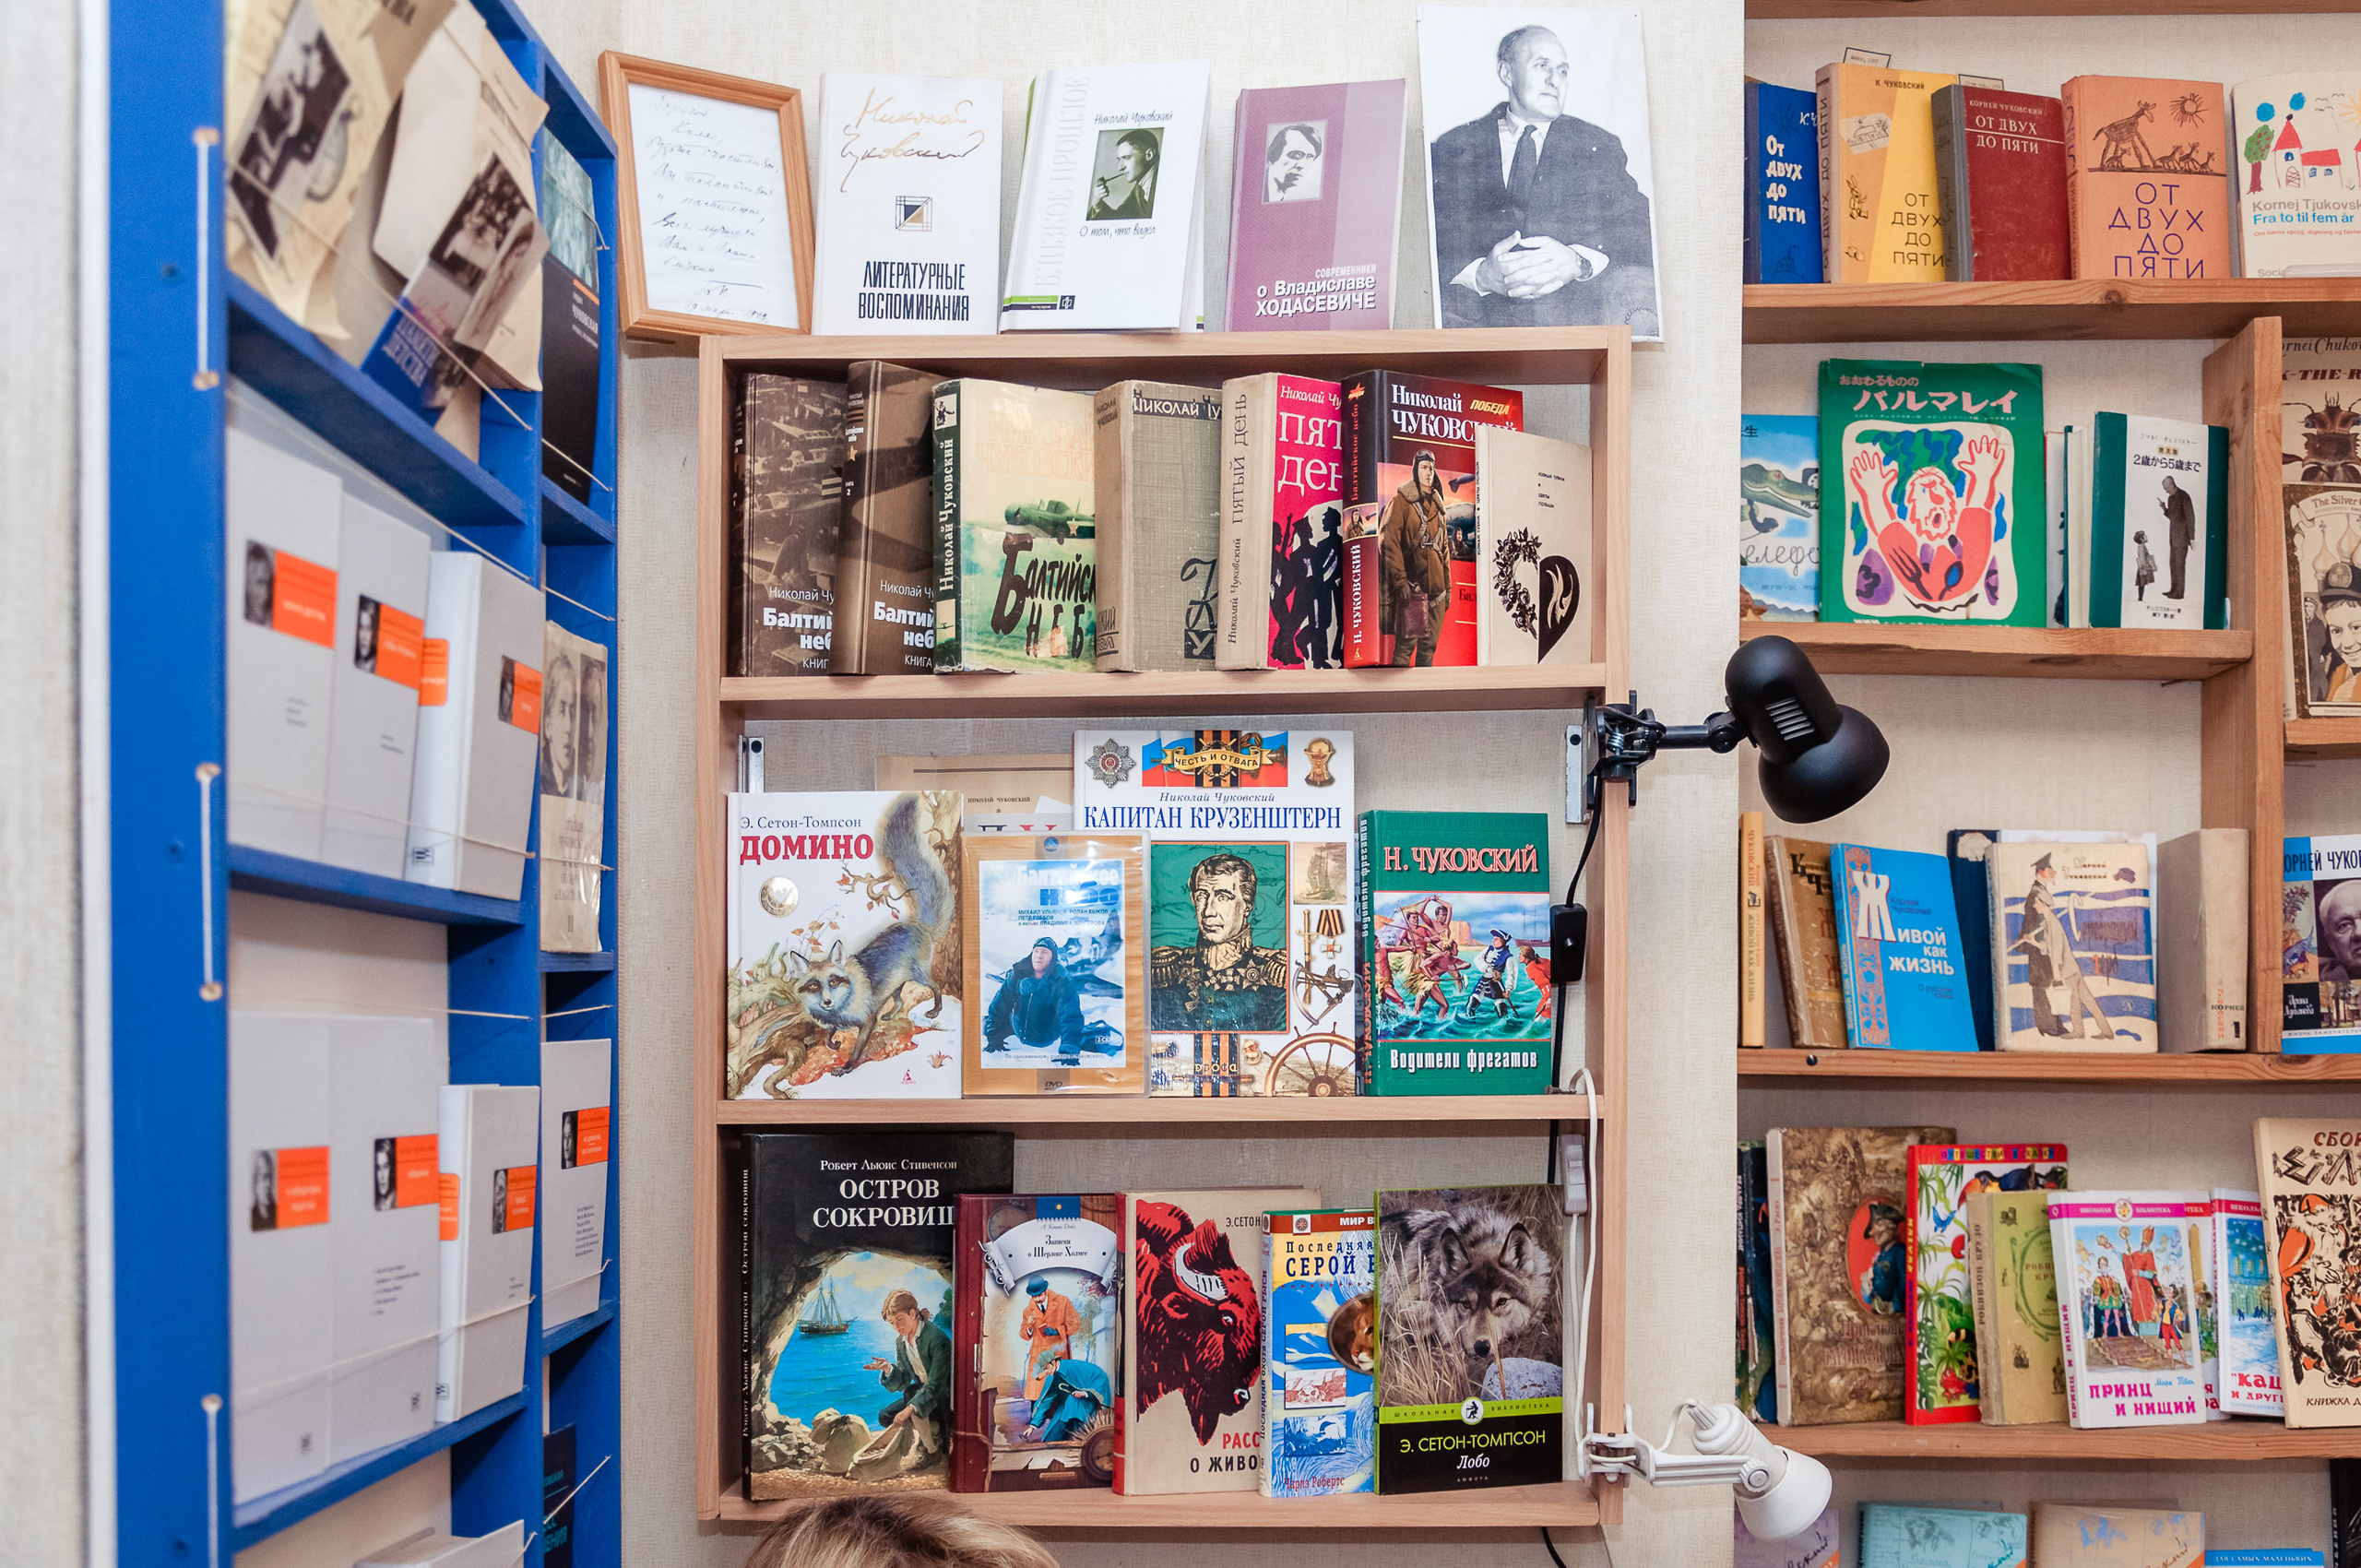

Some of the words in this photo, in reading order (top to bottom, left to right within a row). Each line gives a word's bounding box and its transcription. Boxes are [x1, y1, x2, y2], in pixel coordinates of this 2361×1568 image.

[1884, 80, 1925, 89] ЧУКОВСКИЙ
[1969, 100, 1998, 110] КОРНЕЙ
[1999, 103, 2043, 115] ЧУКОВСКИЙ
[1095, 113, 1130, 125] Николай
[1132, 110, 1174, 127] Чуковский
[1820, 97, 1828, 149] ПЯТИ
[1975, 115, 1996, 129] ОТ
[1999, 118, 2038, 136] ДВУХ
[1975, 135, 1997, 148] ДО
[2002, 137, 2039, 155] ПЯТИ
[1904, 193, 1929, 208] ОТ
[2135, 183, 2180, 206] ОТ
[2252, 199, 2299, 212] Kornej
[1892, 211, 1942, 228] ДВУХ
[2108, 208, 2203, 232] ДВУХ
[2253, 214, 2276, 224] Fra
[2280, 212, 2294, 222] to
[2297, 212, 2308, 222] til
[2312, 212, 2338, 222] fem
[2341, 212, 2355, 222] år
[1079, 226, 1088, 237] О
[1905, 232, 1932, 247] ДО
[2138, 232, 2184, 255] ДО
[1893, 251, 1944, 267] ПЯТИ
[2115, 255, 2203, 278] ПЯТИ
[863, 261, 965, 290] ЛИТЕРАТУРНЫЕ
[1315, 263, 1377, 279] СОВРЕМЕННИКИ
[1257, 285, 1267, 298] о
[1275, 275, 1376, 299] Владиславе
[859, 292, 969, 321] ВОСПОМИНАНИЯ
[1255, 294, 1376, 318] ХОДАСЕВИЧЕ
[1839, 374, 1919, 386] おおわるものの
[1133, 389, 1199, 416] НИКОЛАЙ
[1280, 385, 1325, 404] Николай
[1391, 384, 1462, 412] Николай
[1853, 389, 2018, 414] バルマレイ
[1469, 399, 1510, 416] ПОБЕДА
[1234, 393, 1247, 447] ДЕНЬ
[2133, 454, 2201, 472] 2歳から5歳まで
[939, 437, 957, 523] Чуковский
[1229, 455, 1245, 525] ПЯТЫЙ
[2311, 498, 2330, 507] The
[2331, 495, 2357, 505] Silver
[939, 522, 955, 592] Николай
[1229, 537, 1241, 596] Чуковский
[880, 579, 922, 599] Николай
[1351, 543, 1363, 624] ЧУКОВСКИЙ
[769, 586, 819, 600] Николай
[1227, 598, 1238, 645] Николай
[1353, 626, 1362, 644] Н.
[904, 654, 932, 668] КНИГА
[1175, 755, 1207, 767] ЧЕСТЬ
[1210, 754, 1218, 762] И
[1220, 754, 1259, 767] ОТВАГА
[1158, 792, 1210, 803] Николай
[1214, 792, 1275, 804] Чуковский
[741, 817, 753, 828] Э.
[757, 815, 861, 829] Сетон-Томпсон
[1084, 806, 1183, 828] КАПИТАН
[1190, 806, 1342, 829] КРУЗЕНШТЕРН
[740, 834, 874, 866] ДОМИНО
[1383, 846, 1408, 871] Н.
[1411, 844, 1538, 873] ЧУКОВСКИЙ
[1891, 897, 1919, 906] Корней
[1891, 905, 1932, 916] Чуковский
[1924, 945, 1948, 957] как
[2233, 1022, 2240, 1038] 1
[1390, 1049, 1460, 1074] Водители
[1466, 1049, 1537, 1073] фрегатов
[1364, 1061, 1372, 1085] Н.
[820, 1159, 858, 1171] Роберт
[861, 1159, 896, 1171] Льюис
[901, 1159, 957, 1170] Стивенсон
[839, 1179, 940, 1199] ОСТРОВ
[1340, 1217, 1365, 1226] МИР
[1046, 1234, 1071, 1245] Записки
[1286, 1241, 1374, 1253] Последняя
[1974, 1225, 1982, 1261] КРУЗО
[1033, 1247, 1063, 1258] Шерлоке
[1064, 1246, 1087, 1256] Холмсе
[1286, 1256, 1355, 1277] СЕРОЙ
[1976, 1265, 1986, 1325] РОБИНЗОН
[2060, 1303, 2071, 1352] НИЩИЙ
[2068, 1359, 2073, 1368] И
[2089, 1383, 2153, 1400] ПРИНЦ
[1394, 1408, 1455, 1418] ШКОЛЬНАЯ
[1491, 1403, 1550, 1411] БИБЛИОТЕКА
[2116, 1402, 2126, 1417] И
[2134, 1396, 2196, 1415] НИЩИЙ
[1400, 1439, 1414, 1453] Э.
[1418, 1430, 1546, 1452] СЕТОН-ТОМПСОН
[1191, 1457, 1200, 1474] О
[1456, 1454, 1490, 1469] Лобо
[1284, 1476, 1310, 1491] Чарлз
[1311, 1476, 1345, 1489] Робертс
